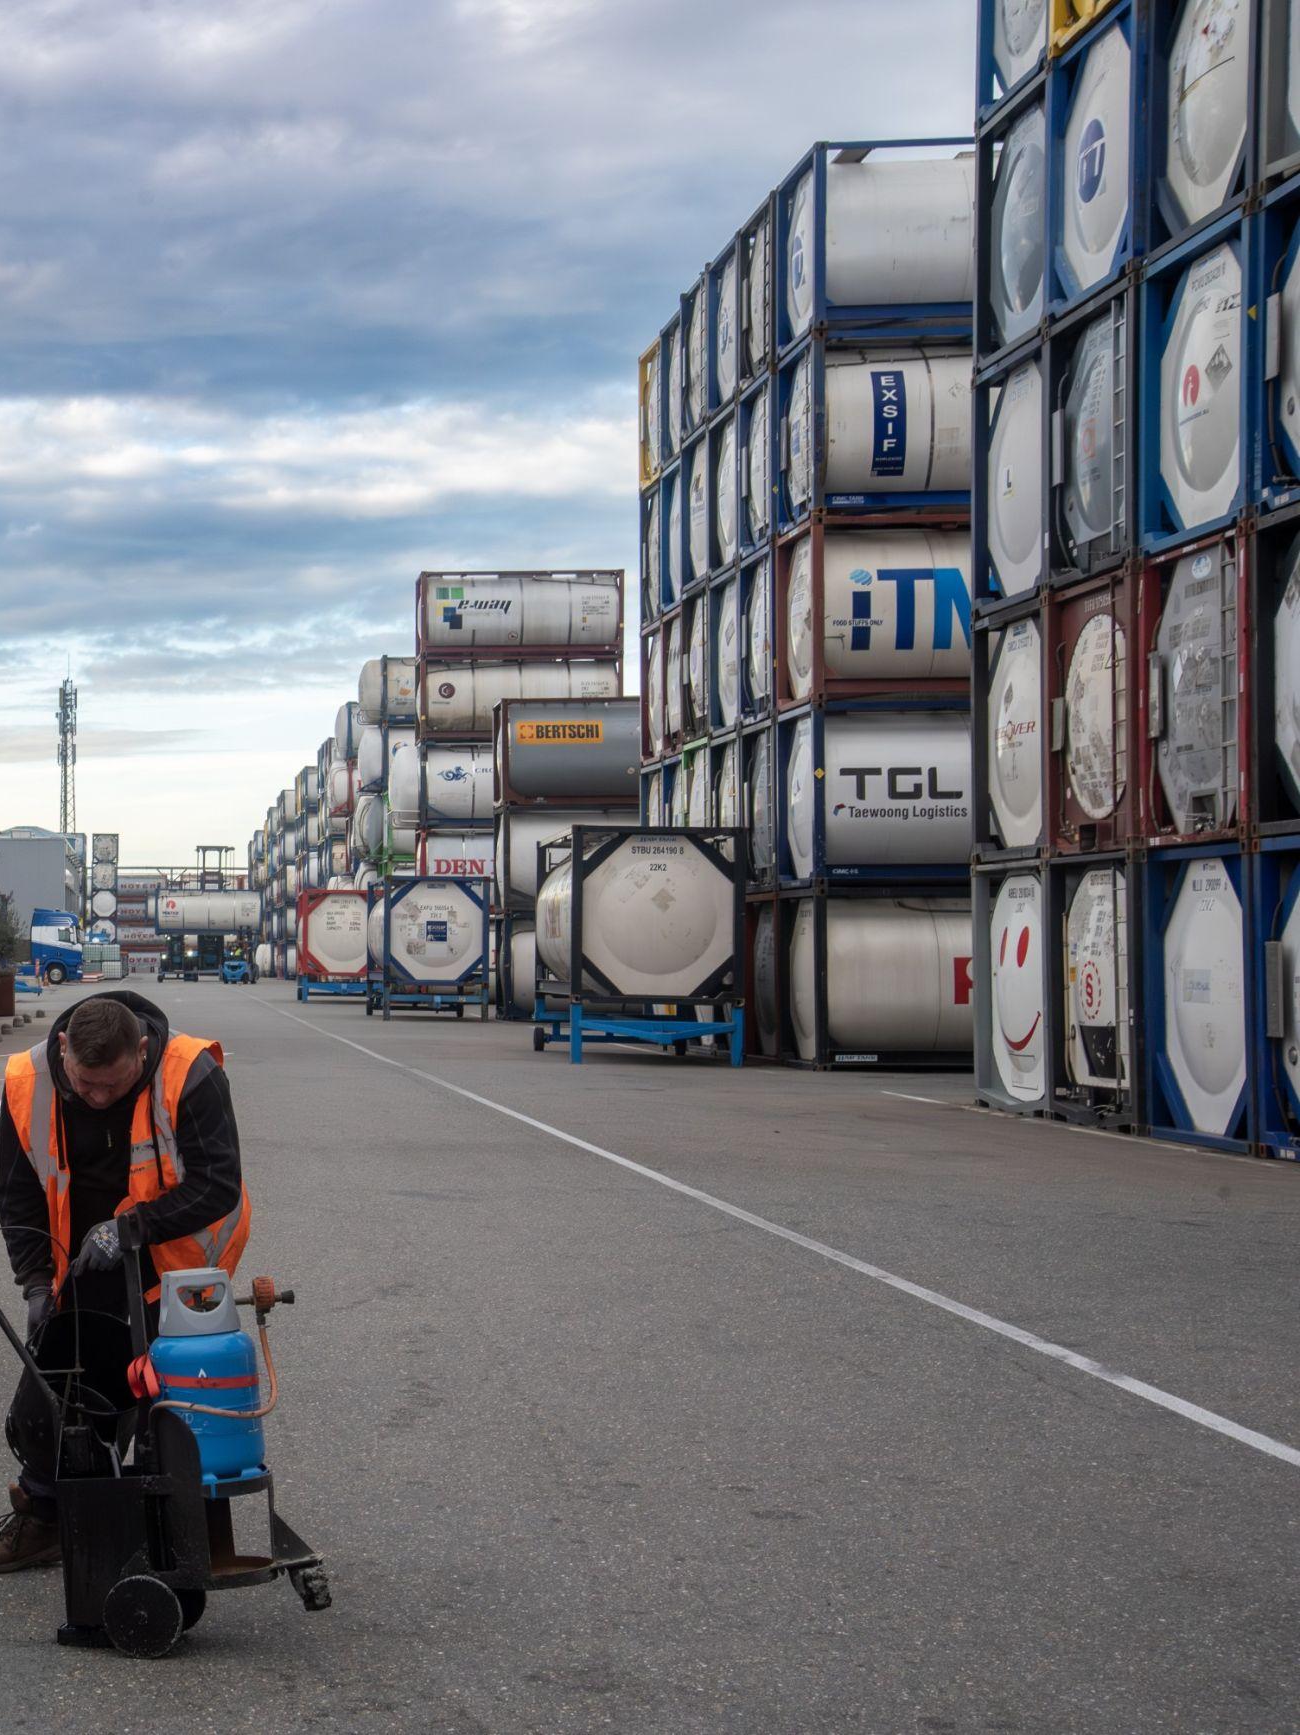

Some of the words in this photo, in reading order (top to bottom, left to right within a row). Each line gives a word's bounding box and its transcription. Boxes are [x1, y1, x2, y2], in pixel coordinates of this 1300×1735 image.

[880, 375, 898, 452] EXSIF
[832, 619, 848, 627] FOOD
[848, 619, 869, 627] STUFFS
[869, 619, 884, 627] ONLY
[535, 723, 600, 740] BERTSCHI
[839, 766, 964, 801] TGL
[848, 805, 909, 820] Taewoong
[912, 805, 968, 820] Logistics
[631, 846, 652, 855] STBU
[652, 846, 678, 855] 264190
[679, 846, 684, 855] 8
[434, 858, 487, 875] DEN
[649, 863, 667, 872] 22K2
